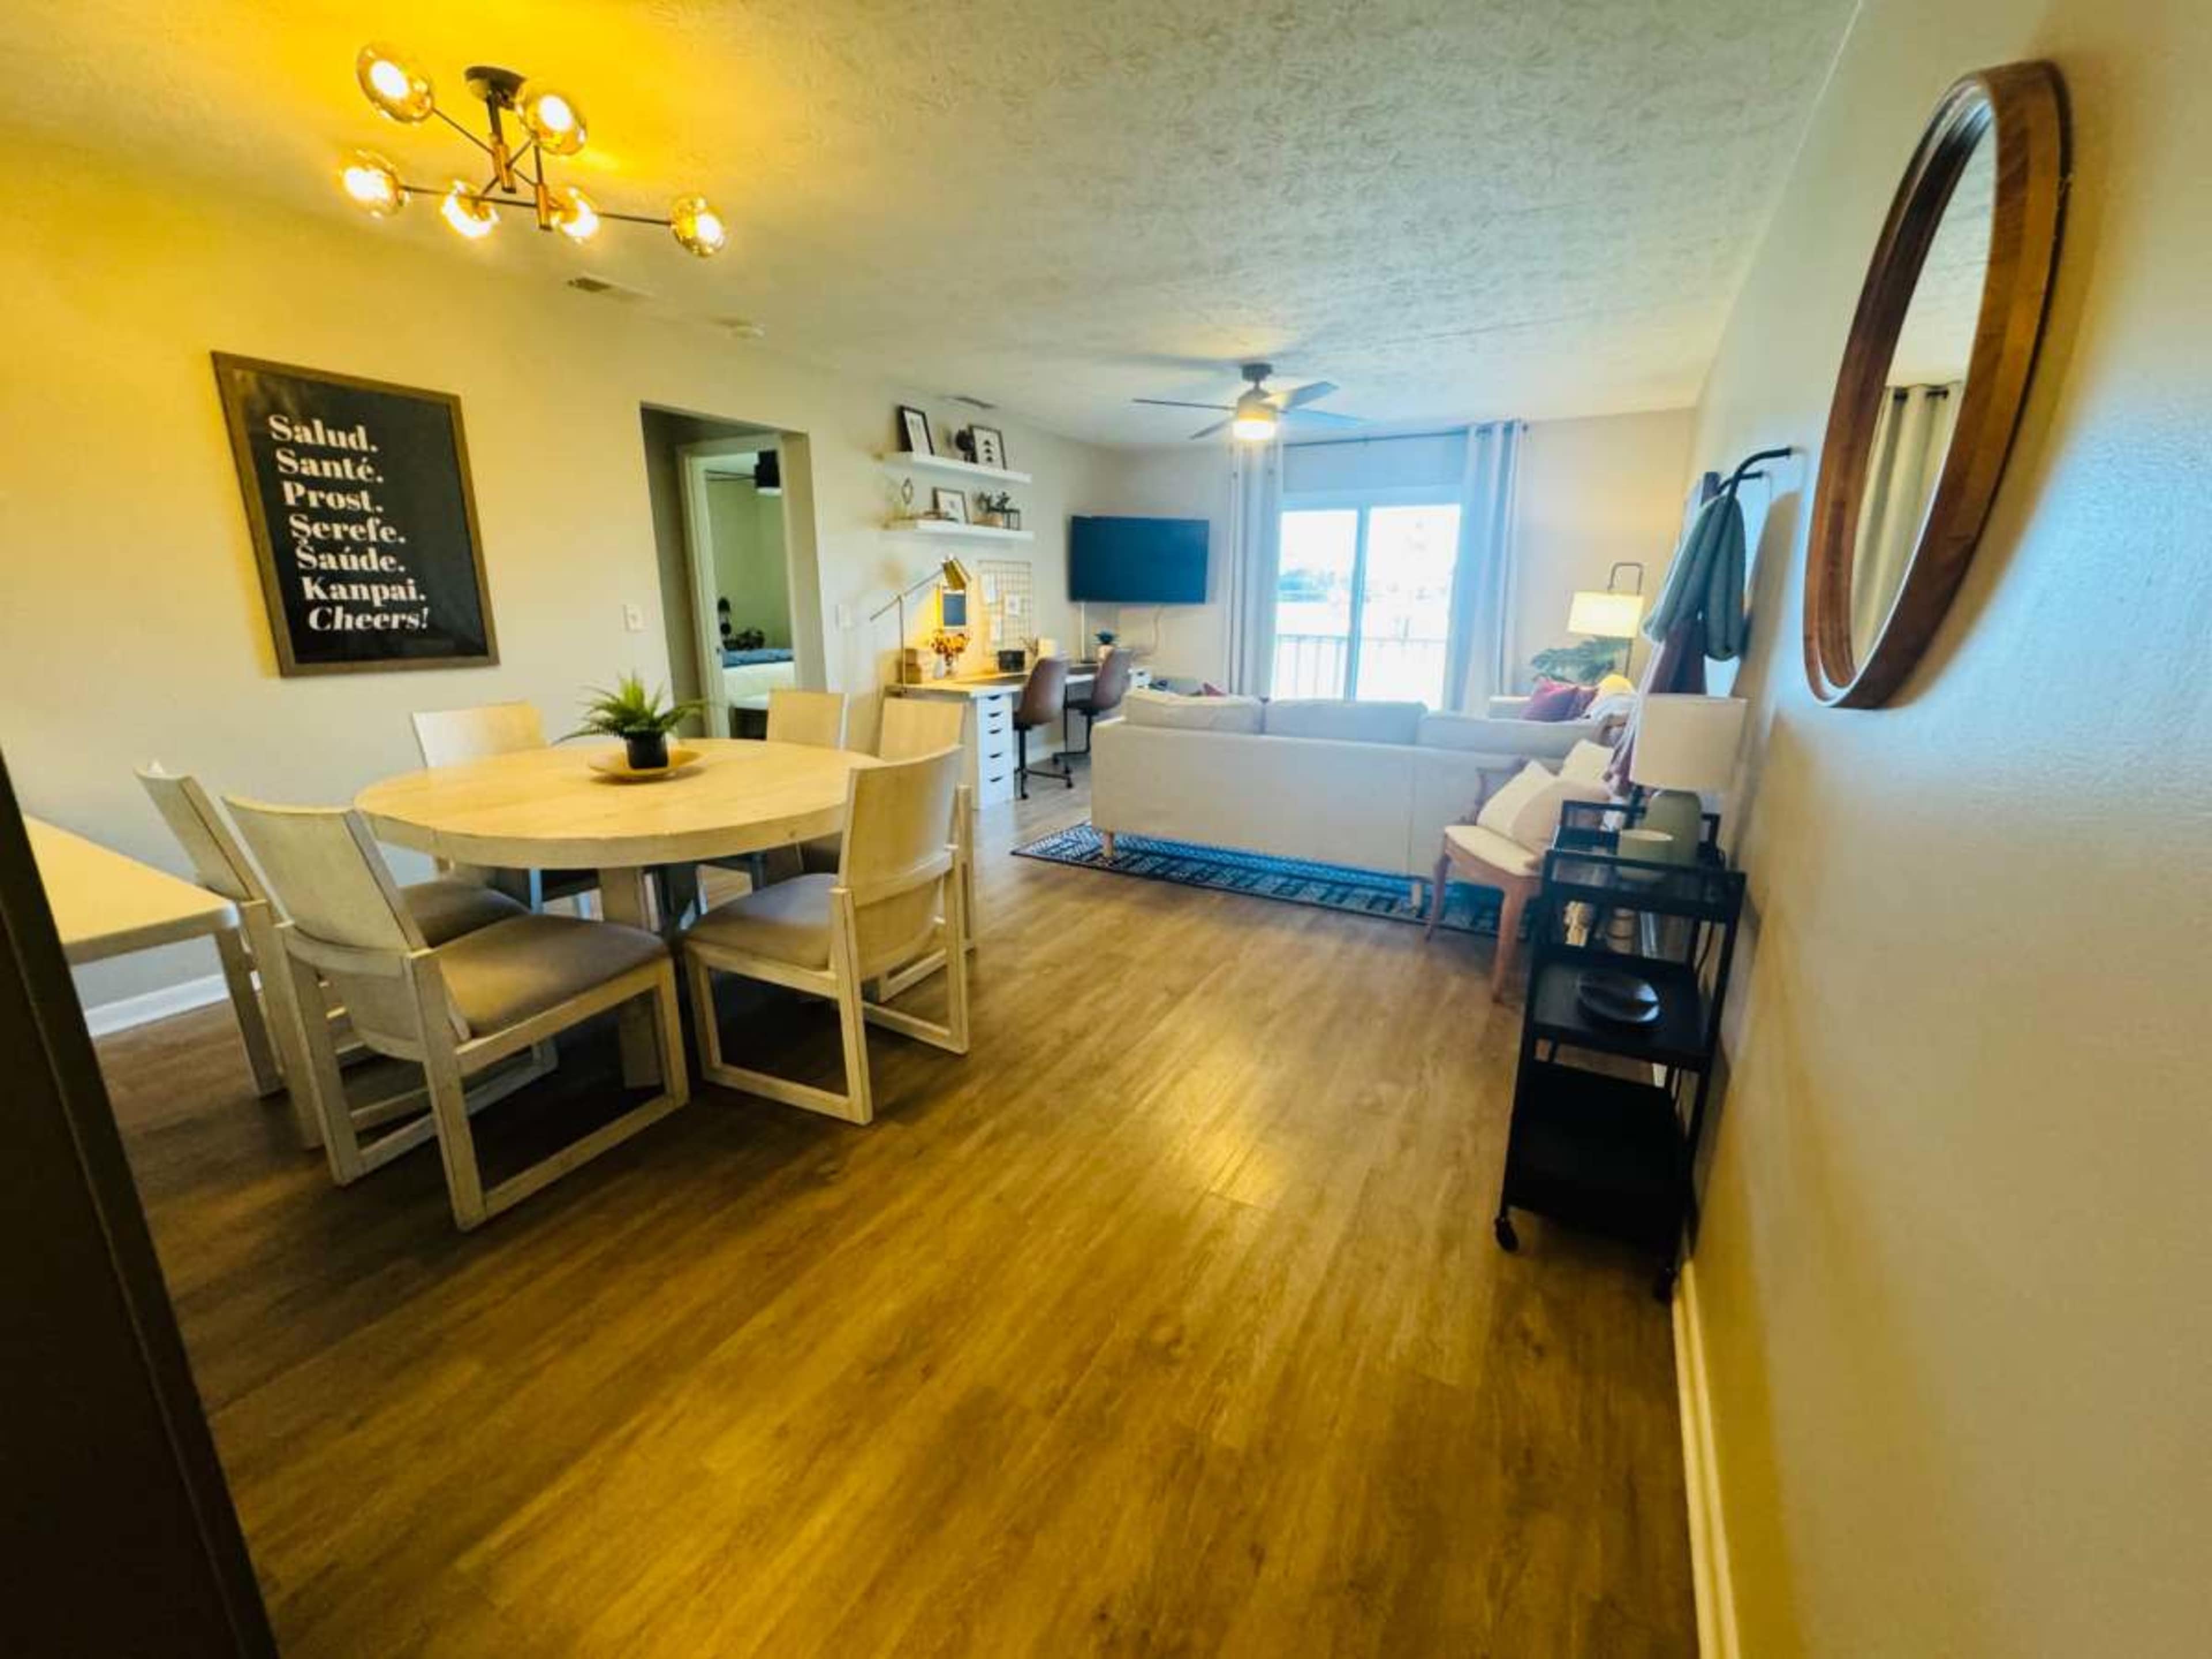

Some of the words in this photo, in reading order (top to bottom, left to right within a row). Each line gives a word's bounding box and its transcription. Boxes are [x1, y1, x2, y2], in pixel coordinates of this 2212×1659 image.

[268, 414, 378, 453] Salud.
[276, 447, 384, 483] Santé.
[283, 480, 384, 513] Prost.
[301, 577, 426, 607] Kanpai.
[308, 606, 429, 631] Cheers!
